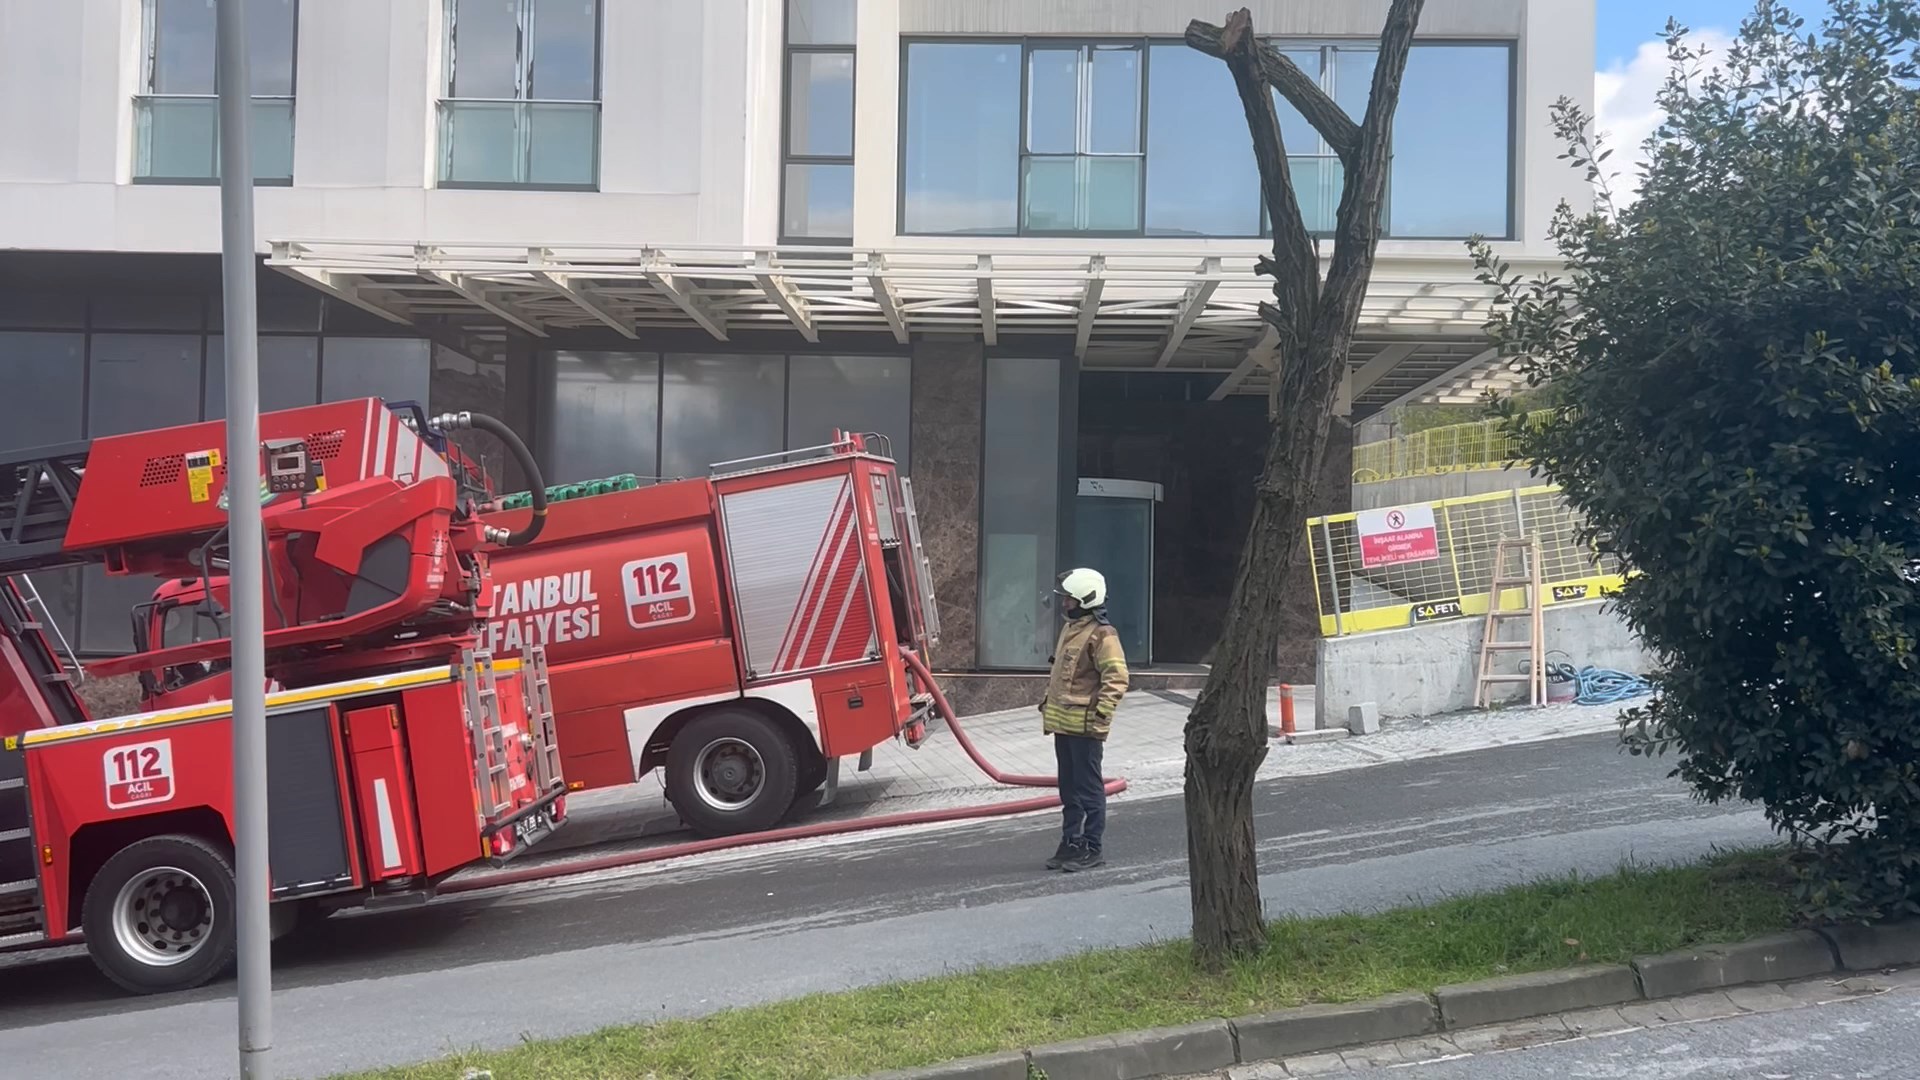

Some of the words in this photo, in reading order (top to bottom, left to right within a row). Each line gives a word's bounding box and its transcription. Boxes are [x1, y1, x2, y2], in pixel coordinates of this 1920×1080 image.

[488, 569, 598, 618] TANBUL
[632, 561, 681, 597] 112
[1556, 586, 1586, 597] SAFE
[113, 746, 162, 781] 112
